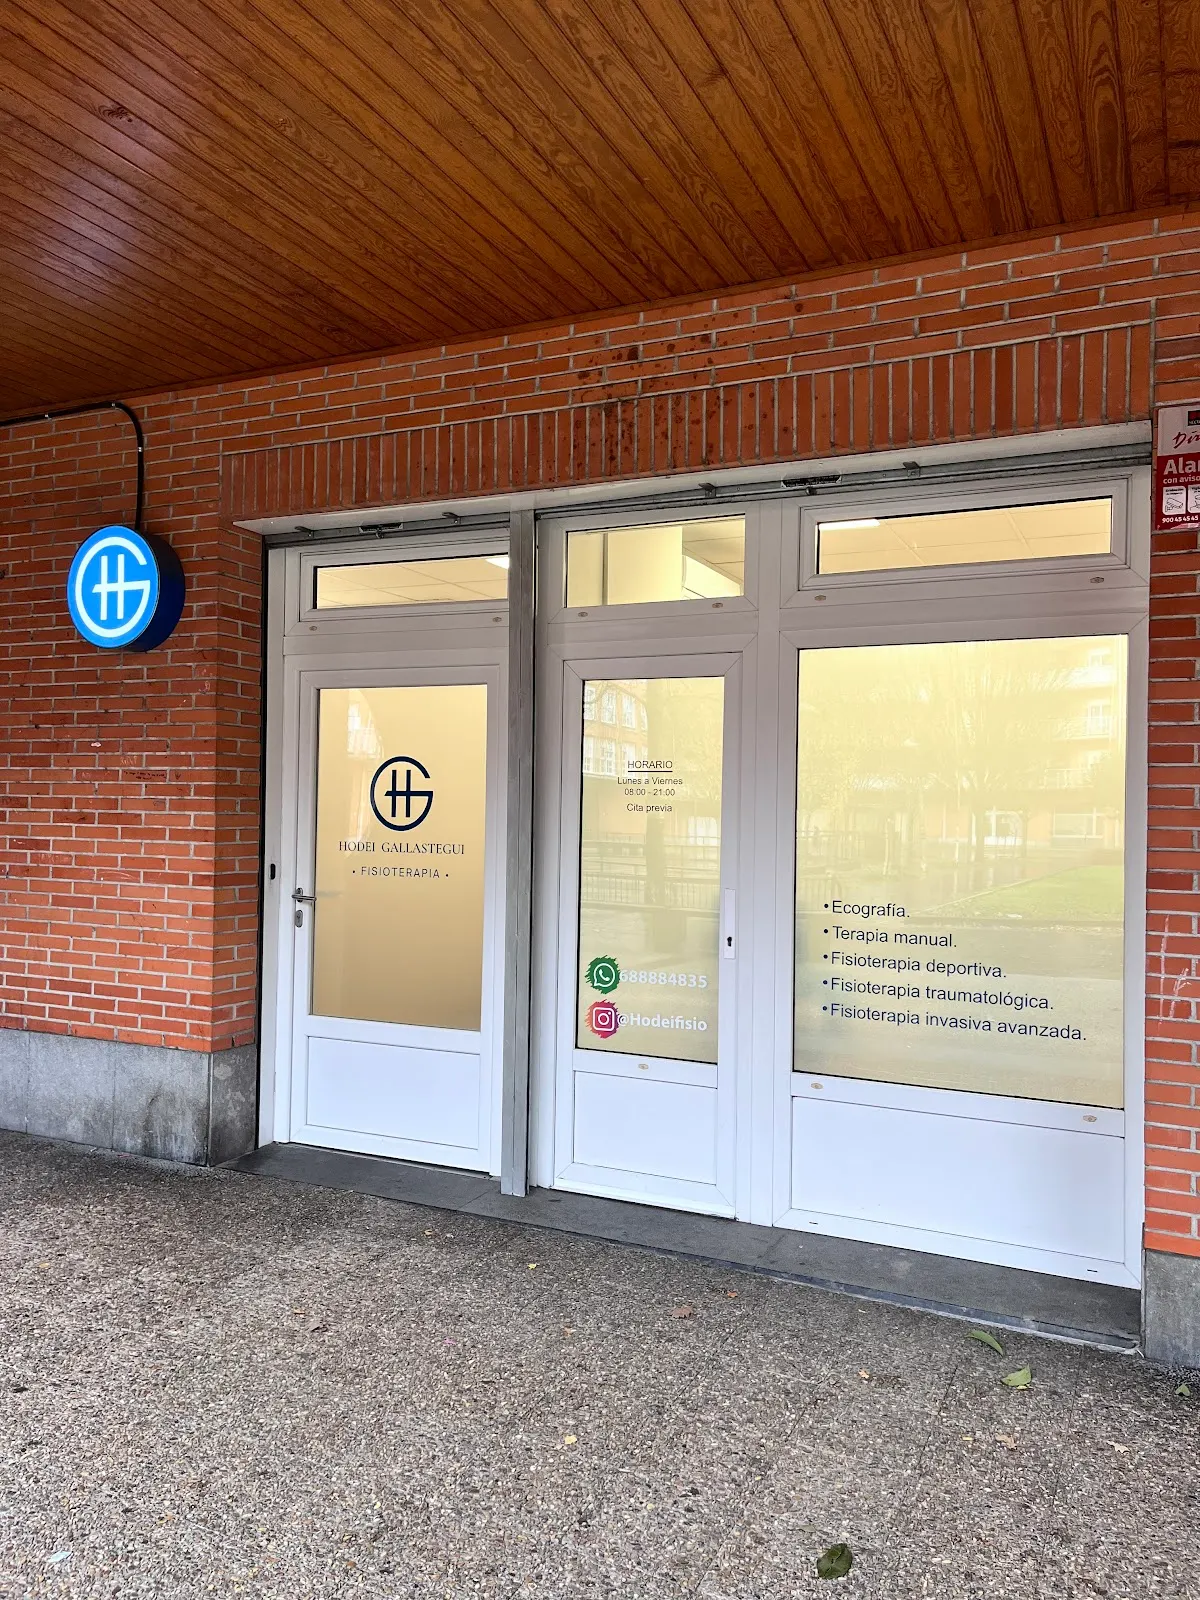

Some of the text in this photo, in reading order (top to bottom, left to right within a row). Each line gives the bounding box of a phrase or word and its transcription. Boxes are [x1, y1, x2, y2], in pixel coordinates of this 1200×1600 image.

[1163, 457, 1200, 475] Ala
[628, 760, 673, 769] HORARIO
[617, 777, 642, 785] Lunes
[651, 777, 683, 785] Viernes
[624, 788, 646, 796] 08:00
[653, 788, 675, 796] 21:00
[626, 803, 673, 813] Cita previa
[339, 841, 465, 855] HODEI GALLASTEGUI
[361, 866, 440, 878] FISIOTERAPIA
[832, 900, 910, 918] Ecografía.
[832, 925, 957, 948] Terapia manual.
[831, 952, 1007, 978] Fisioterapia deportiva.
[619, 969, 708, 989] 688884835
[831, 978, 1054, 1011] Fisioterapia traumatológica.
[617, 1012, 708, 1031] @Hodeifisio
[831, 1003, 1087, 1041] Fisioterapia invasiva avanzada.
